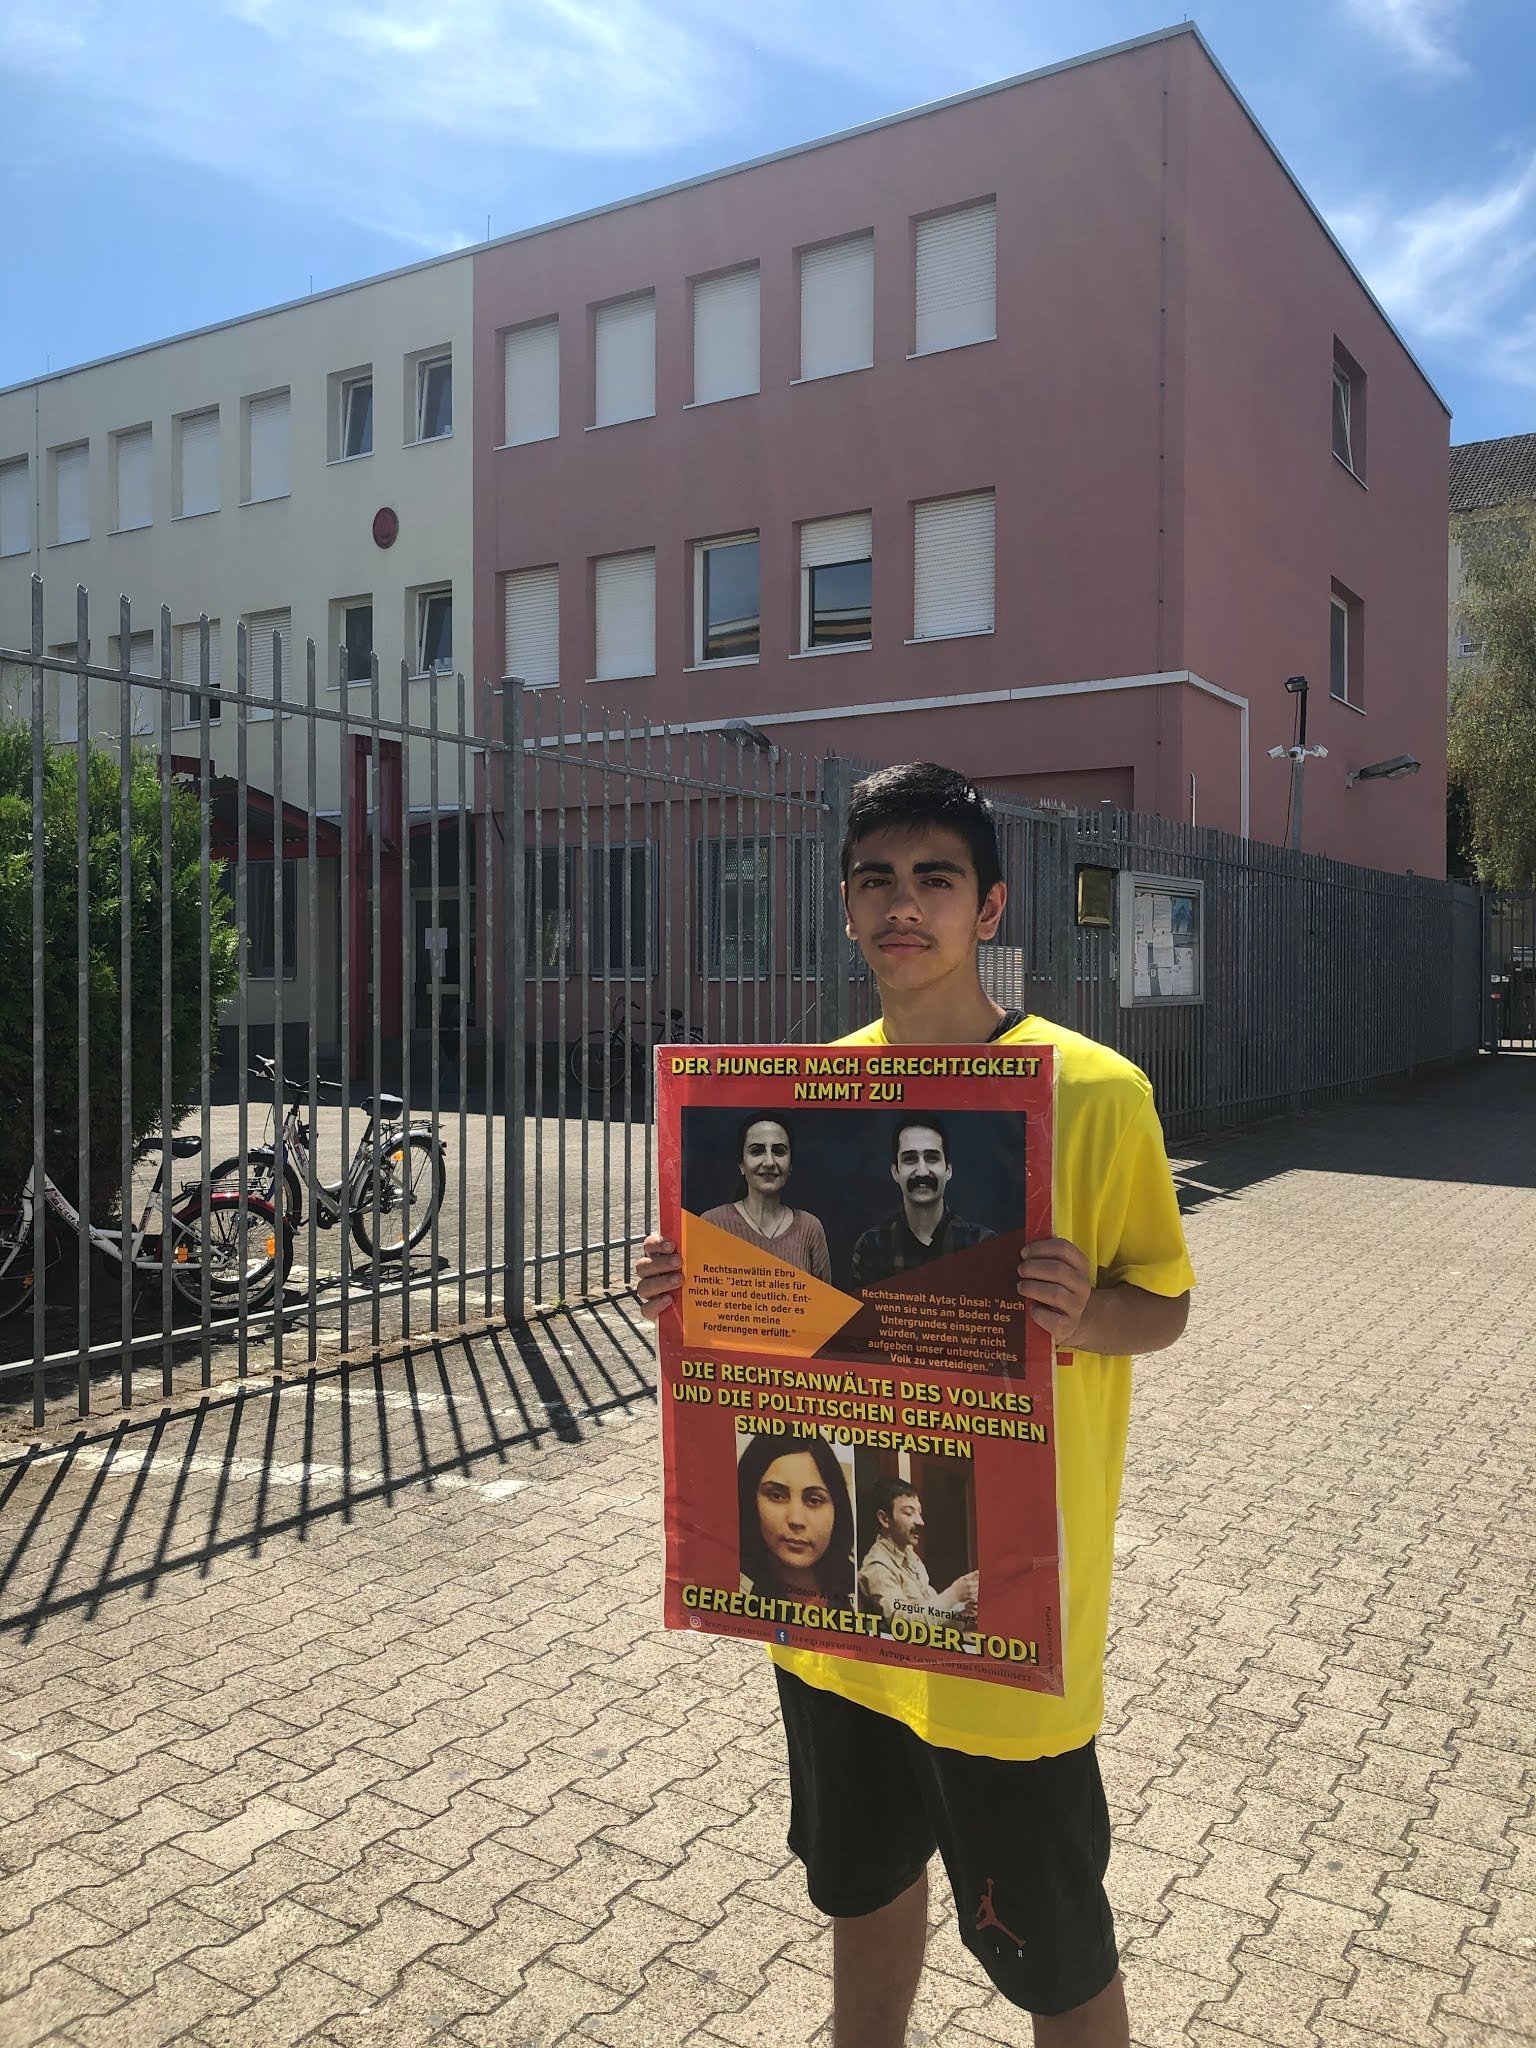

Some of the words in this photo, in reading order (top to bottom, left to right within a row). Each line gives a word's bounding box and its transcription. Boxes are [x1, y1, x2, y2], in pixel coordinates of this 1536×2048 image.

[671, 1057, 711, 1075] DER
[716, 1057, 800, 1075] HUNGER
[805, 1057, 860, 1076] NACH
[865, 1057, 1041, 1077] GERECHTIGKEIT
[794, 1082, 863, 1101] NIMMT
[868, 1082, 903, 1102] ZU!
[703, 1264, 772, 1277] Rechtsanwältin
[774, 1268, 796, 1278] Ebru
[693, 1275, 723, 1285] Timtik:
[726, 1277, 752, 1287] "Jetzt
[755, 1278, 766, 1288] ist
[768, 1279, 790, 1290] alles
[793, 1281, 807, 1291] für
[688, 1287, 709, 1296] mich
[711, 1287, 729, 1297] klar
[731, 1290, 748, 1299] und
[750, 1290, 790, 1302] deutlich.
[792, 1294, 812, 1303] Ent-
[862, 1288, 927, 1303] Rechtsanwalt
[928, 1294, 957, 1307] Aytaç
[959, 1293, 992, 1308] Ünsal:
[994, 1298, 1025, 1311] "Auch
[695, 1299, 722, 1308] weder
[724, 1301, 753, 1311] sterbe
[755, 1303, 768, 1312] ich
[771, 1304, 792, 1314] oder
[794, 1307, 805, 1315] es
[874, 1302, 901, 1313] wenn
[903, 1304, 918, 1314] sie
[920, 1307, 938, 1316] uns
[940, 1309, 955, 1318] am
[958, 1309, 990, 1321] Boden
[993, 1312, 1011, 1323] des
[717, 1312, 750, 1323] werden
[752, 1315, 781, 1325] meine
[881, 1314, 948, 1330] Untergrundes
[950, 1321, 1005, 1335] einsperren
[703, 1322, 758, 1336] Forderungen
[760, 1327, 797, 1338] erfüllt."
[879, 1327, 919, 1341] würden,
[921, 1333, 959, 1344] werden
[961, 1335, 978, 1345] wir
[980, 1337, 1007, 1348] nicht
[868, 1338, 913, 1352] aufgeben
[916, 1344, 944, 1355] unser
[946, 1346, 1018, 1363] unterdrücktes
[890, 1353, 912, 1364] Volk
[914, 1356, 926, 1365] zu
[928, 1357, 994, 1372] verteidigen."
[681, 1360, 716, 1380] DIE
[721, 1363, 894, 1398] RECHTSANWÄLTE
[900, 1381, 942, 1403] DES
[947, 1386, 1033, 1414] VOLKES
[672, 1383, 713, 1403] UND
[718, 1388, 753, 1408] DIE
[758, 1392, 895, 1424] POLITISCHEN
[901, 1407, 1046, 1443] GEFANGENEN
[736, 1415, 786, 1436] SIND
[792, 1420, 818, 1440] IM
[824, 1424, 972, 1459] TODESFASTEN
[893, 1599, 925, 1615] Özgür
[927, 1605, 978, 1624] Karakaya
[681, 1584, 883, 1637] GERECHTIGKEIT
[890, 1617, 965, 1653] ODER
[969, 1631, 1039, 1664] TOD!
[878, 1647, 911, 1662] Avrupa
